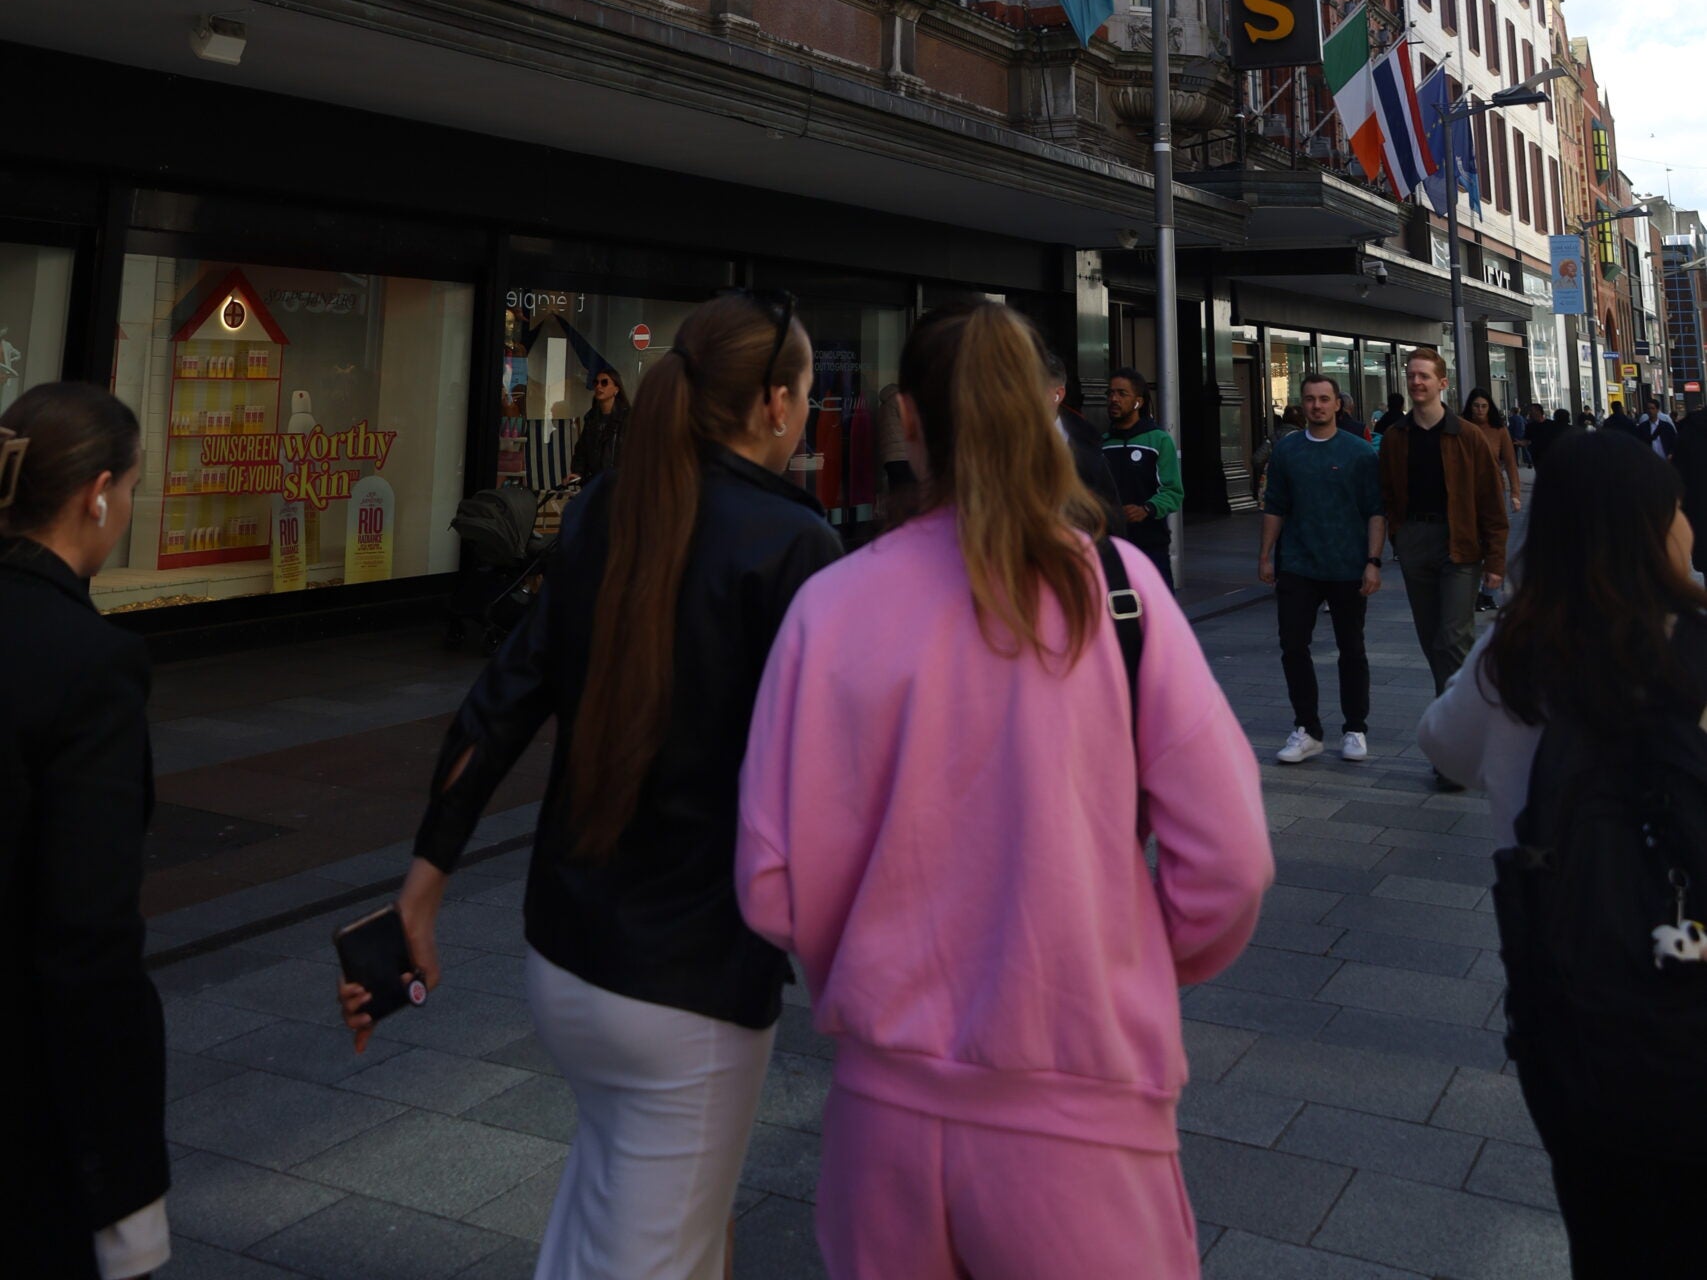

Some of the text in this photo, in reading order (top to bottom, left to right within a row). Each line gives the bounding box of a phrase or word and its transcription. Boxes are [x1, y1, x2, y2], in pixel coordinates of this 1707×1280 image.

[202, 420, 396, 470] SUNSCREEN worthy
[228, 467, 245, 494] OF
[247, 464, 283, 493] YOUR
[279, 517, 299, 547] RIO
[358, 507, 384, 534] RIO
